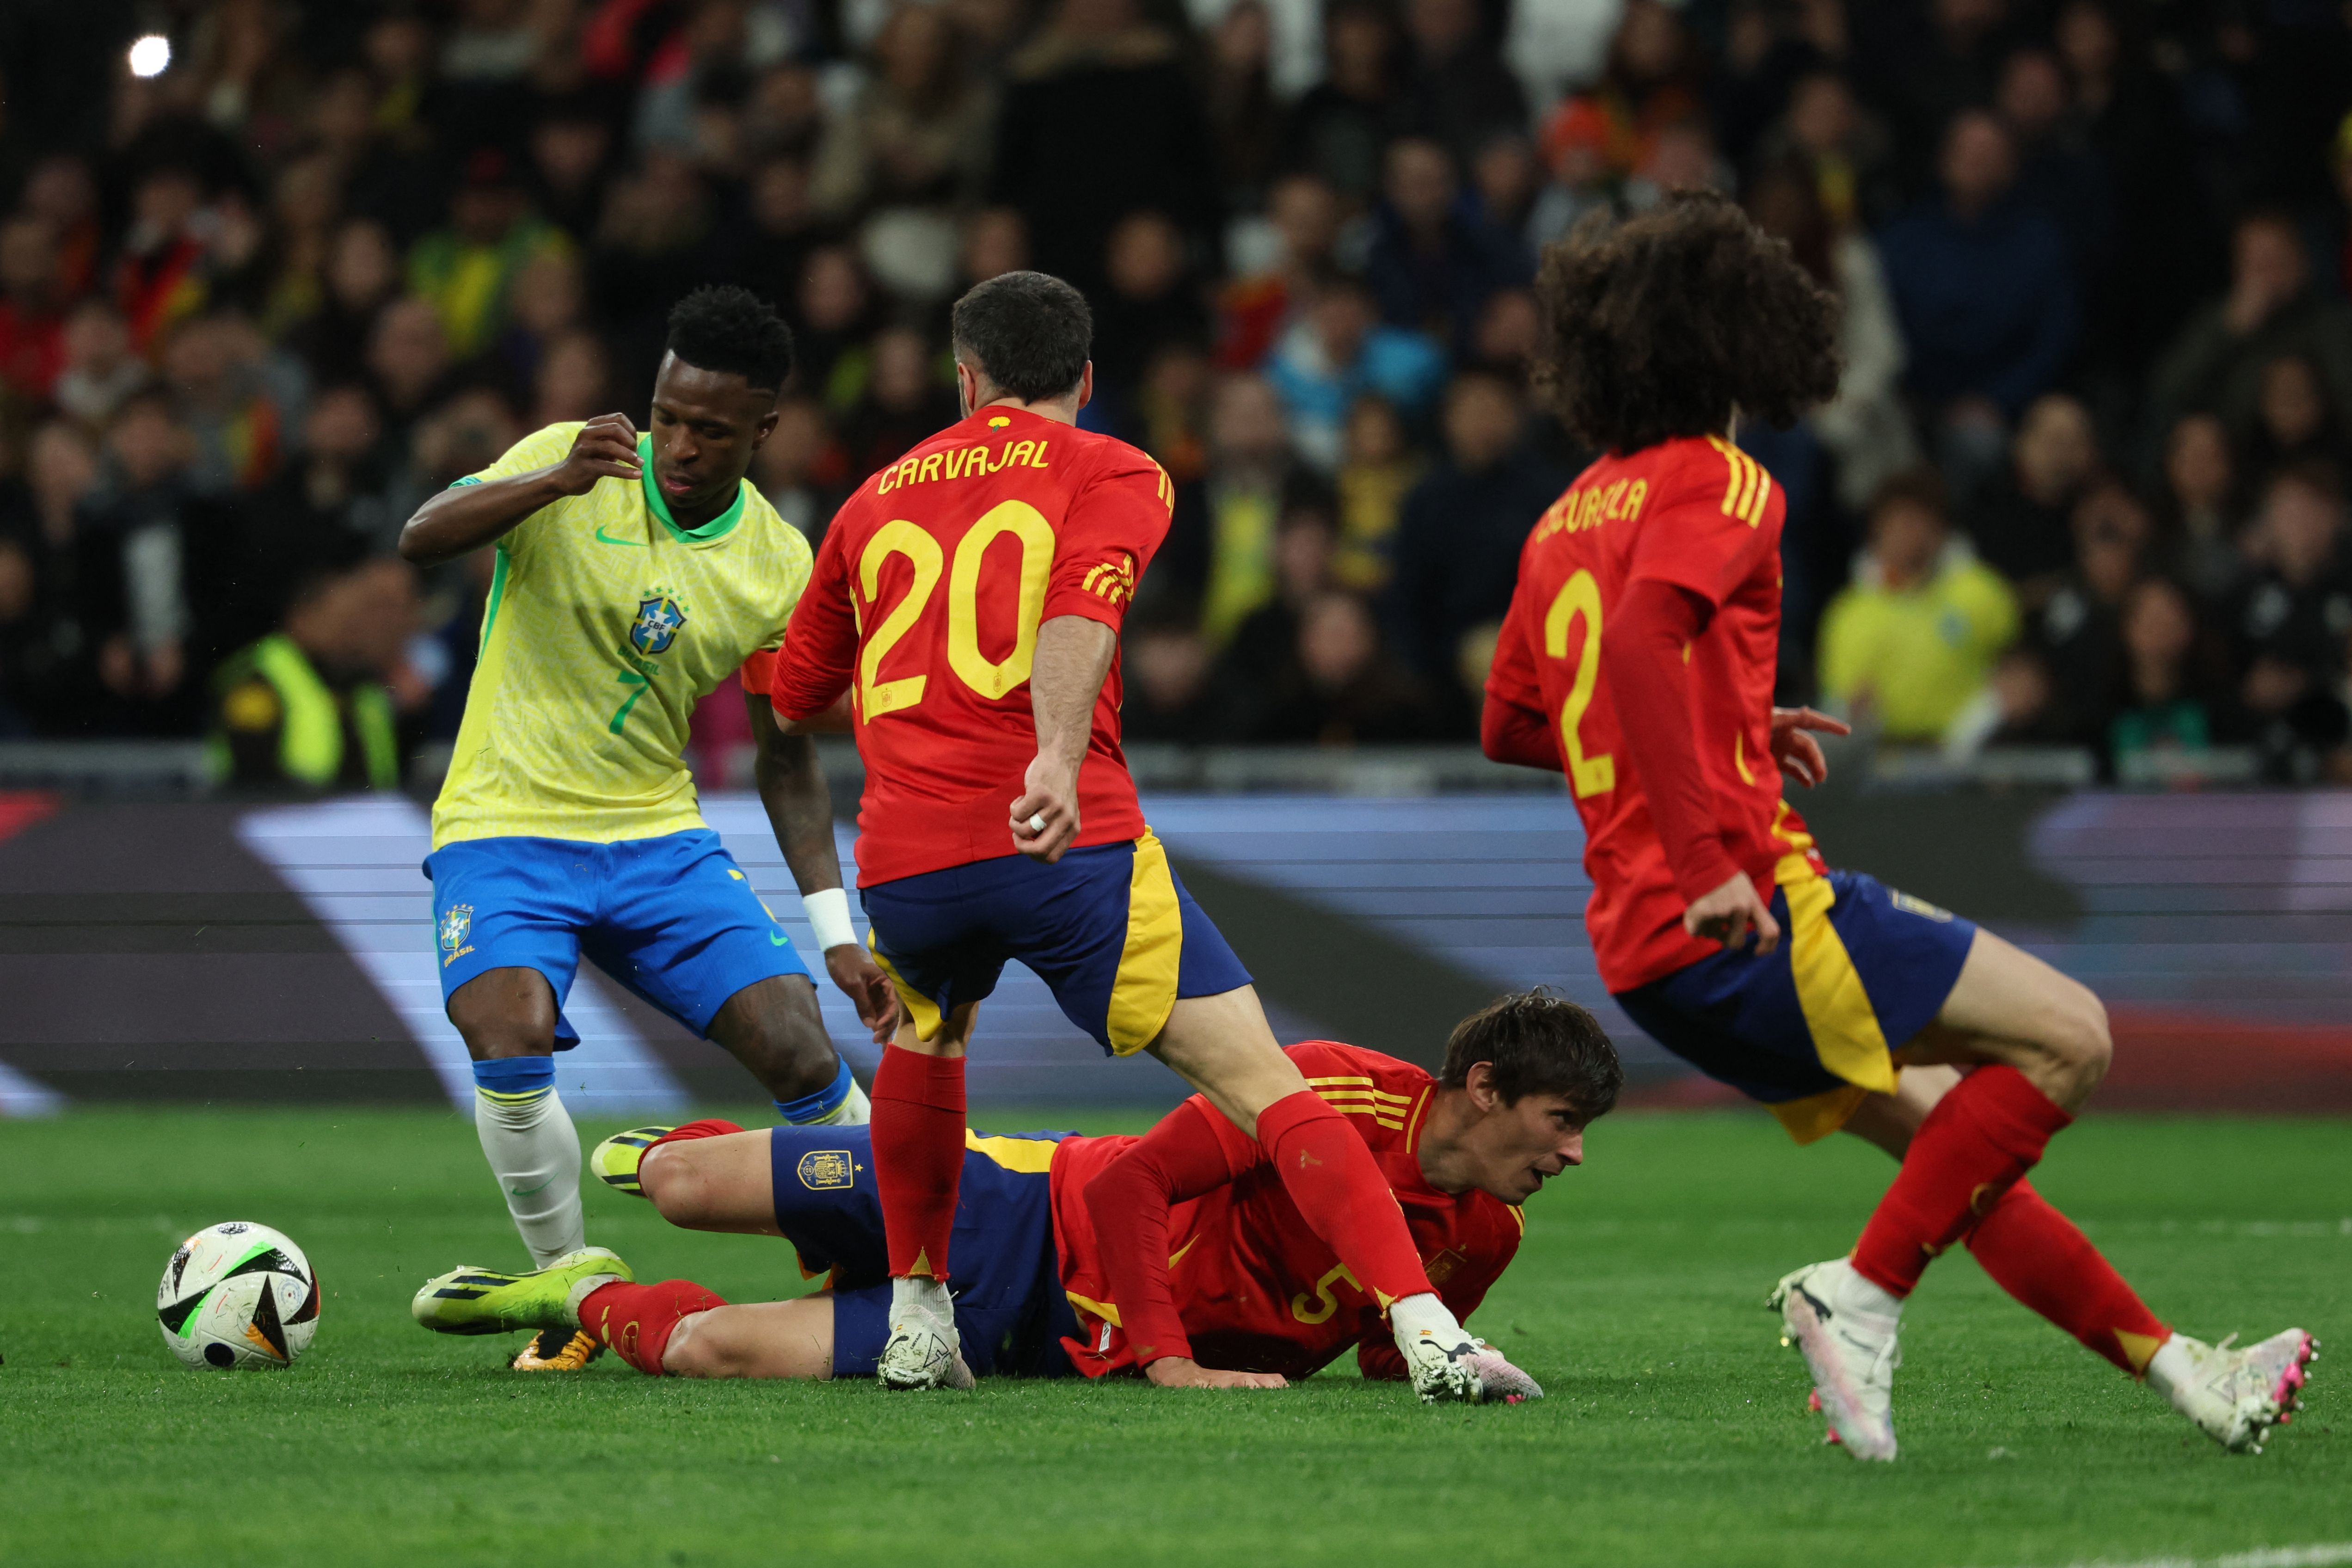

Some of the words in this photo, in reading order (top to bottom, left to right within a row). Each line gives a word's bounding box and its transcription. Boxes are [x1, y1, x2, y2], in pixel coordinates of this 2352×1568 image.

[878, 440, 1049, 495] CARVAJAL
[648, 620, 666, 631] CBF
[860, 499, 1056, 726] 20
[617, 645, 659, 676] BRASIL
[1545, 568, 1615, 799] 2
[609, 670, 651, 735] 7
[444, 945, 476, 968] BRASIL
[449, 924, 461, 934] CBF
[1292, 1262, 1363, 1324] 5
